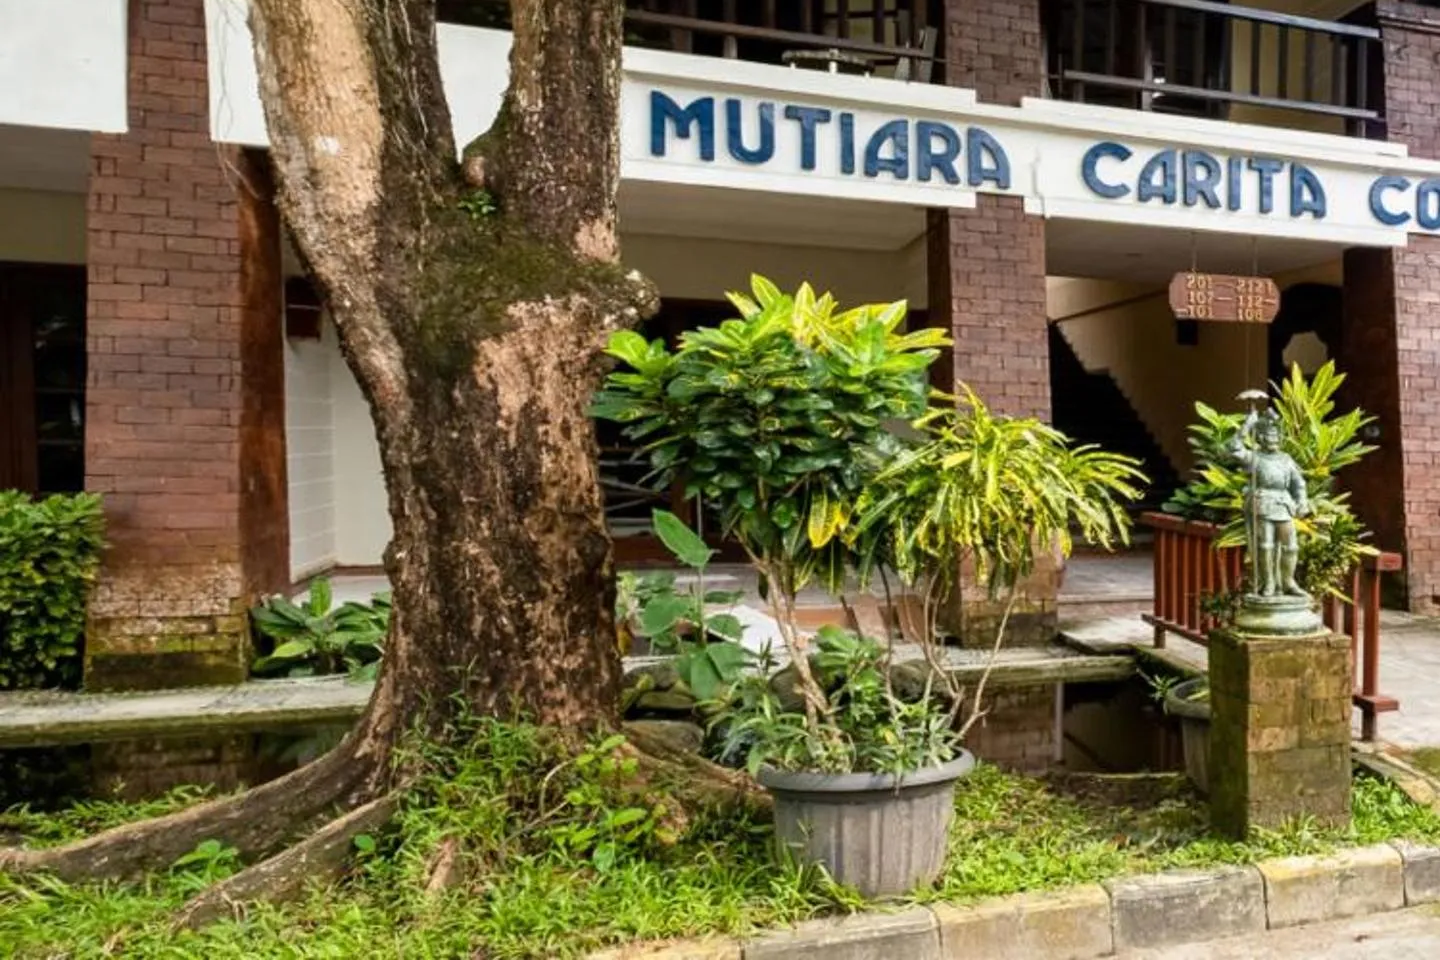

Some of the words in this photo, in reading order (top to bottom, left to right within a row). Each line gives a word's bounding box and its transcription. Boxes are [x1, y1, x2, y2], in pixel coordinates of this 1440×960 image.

[650, 89, 1011, 190] MUTIARA
[1081, 140, 1327, 220] CARITA
[1187, 275, 1213, 289] 201
[1238, 295, 1262, 308] 112
[1187, 305, 1213, 318] 101
